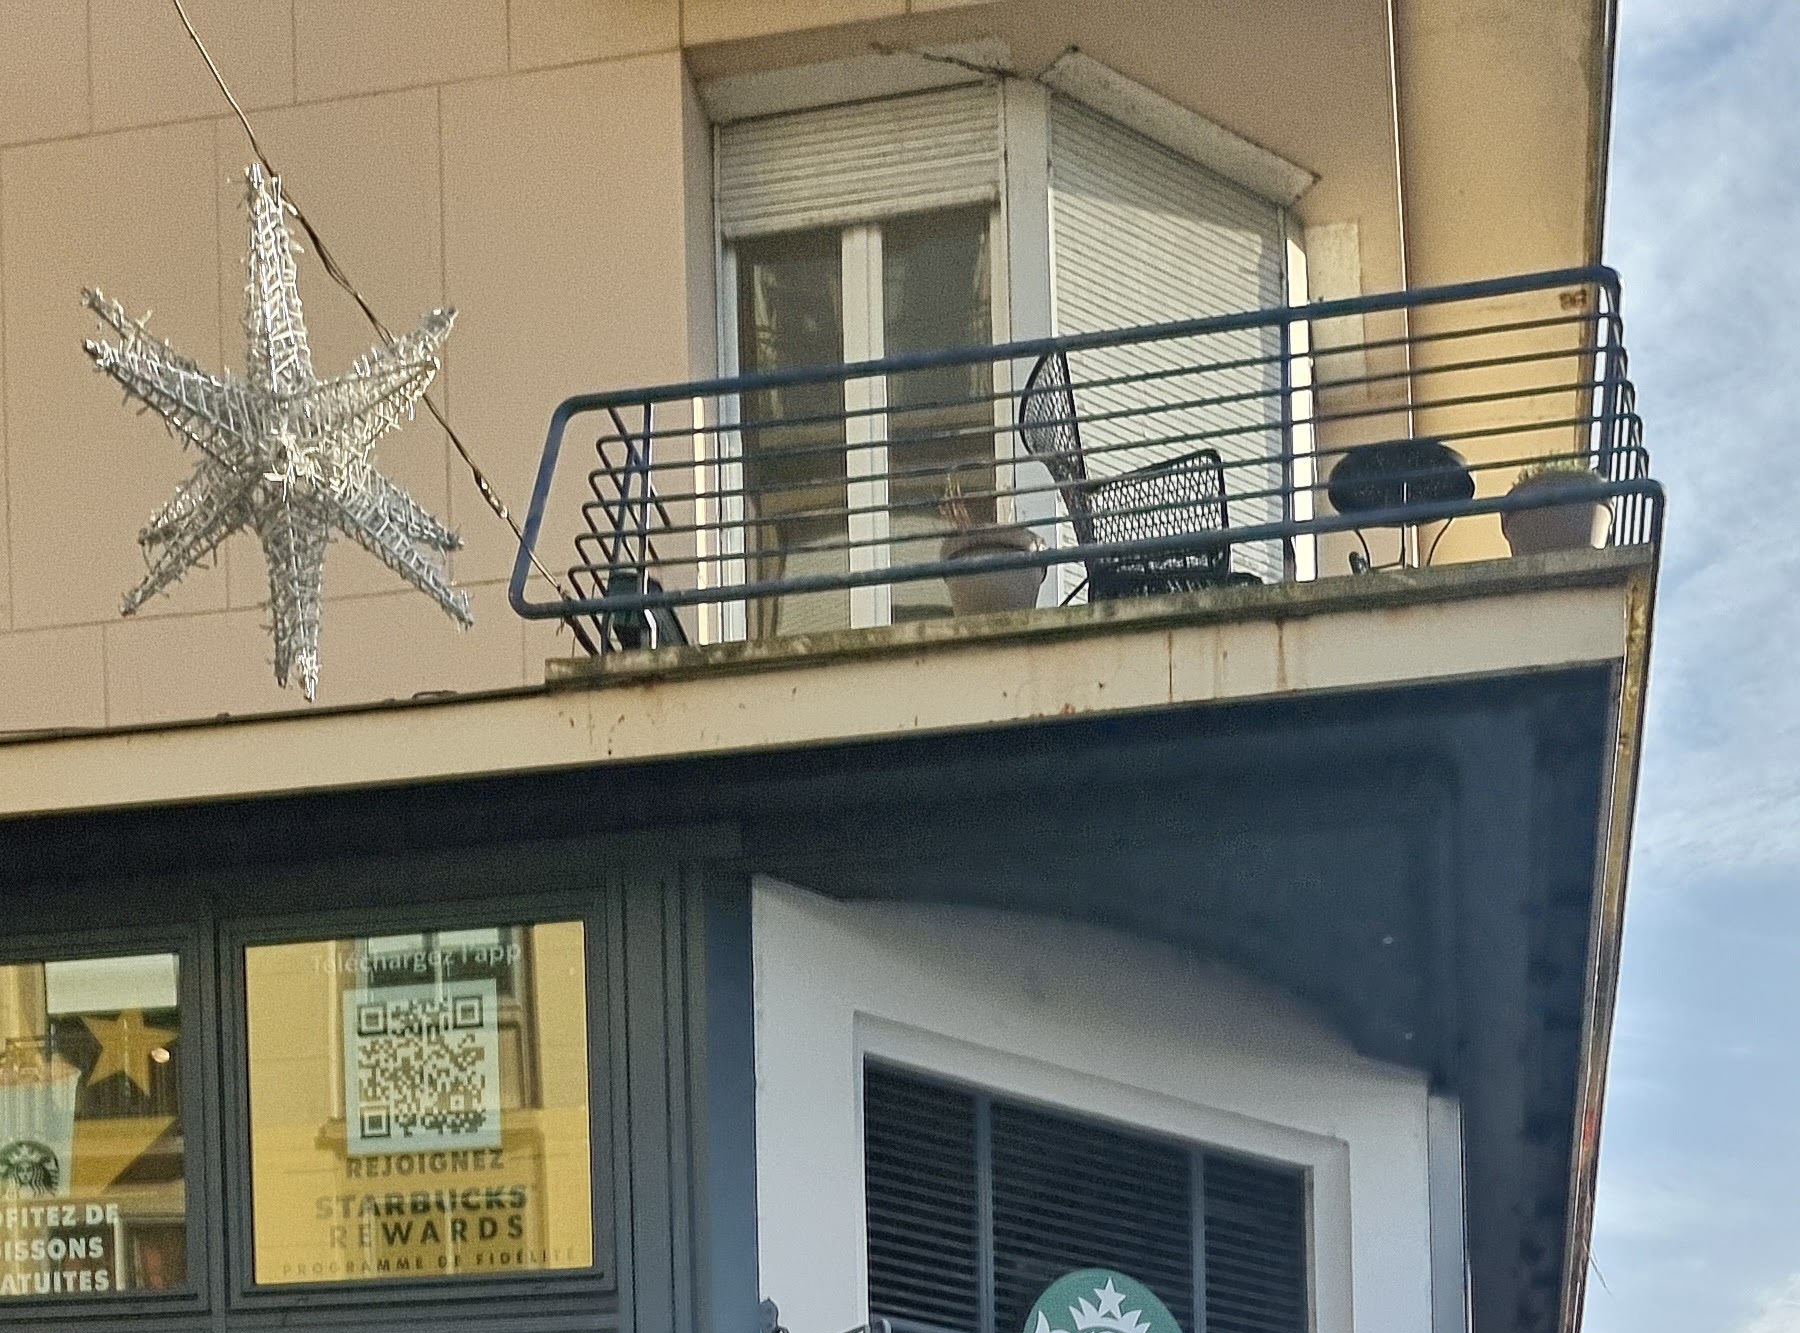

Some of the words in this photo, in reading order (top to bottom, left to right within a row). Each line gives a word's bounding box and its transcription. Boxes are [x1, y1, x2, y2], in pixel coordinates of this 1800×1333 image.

[345, 1149, 504, 1180] REJOIGNEZ
[315, 1184, 528, 1219] STARBUCKS
[0, 1204, 76, 1229] FITEZ
[85, 1203, 119, 1225] DE
[330, 1214, 524, 1249] REWARDS
[0, 1236, 104, 1262] ISSONS
[282, 1256, 424, 1277] PROGRAMME
